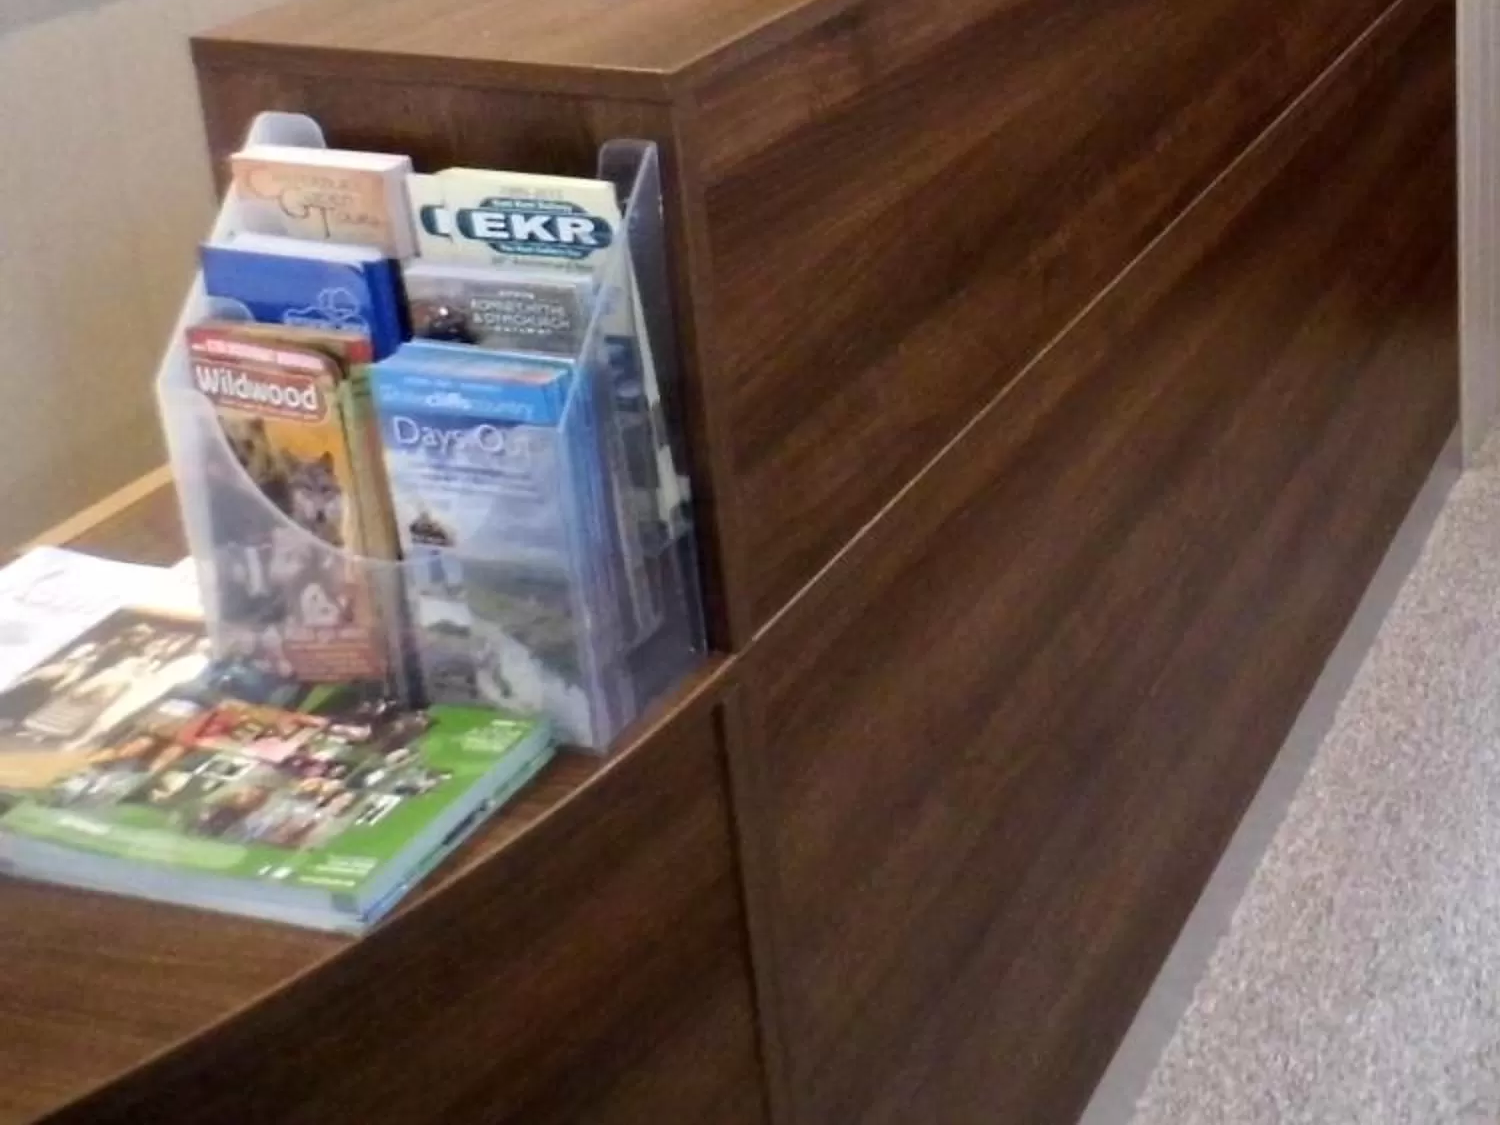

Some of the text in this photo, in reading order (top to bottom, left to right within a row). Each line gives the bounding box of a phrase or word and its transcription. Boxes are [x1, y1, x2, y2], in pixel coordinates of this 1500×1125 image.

[471, 210, 598, 246] EKR
[195, 364, 318, 411] Wildwood
[393, 415, 467, 456] Days
